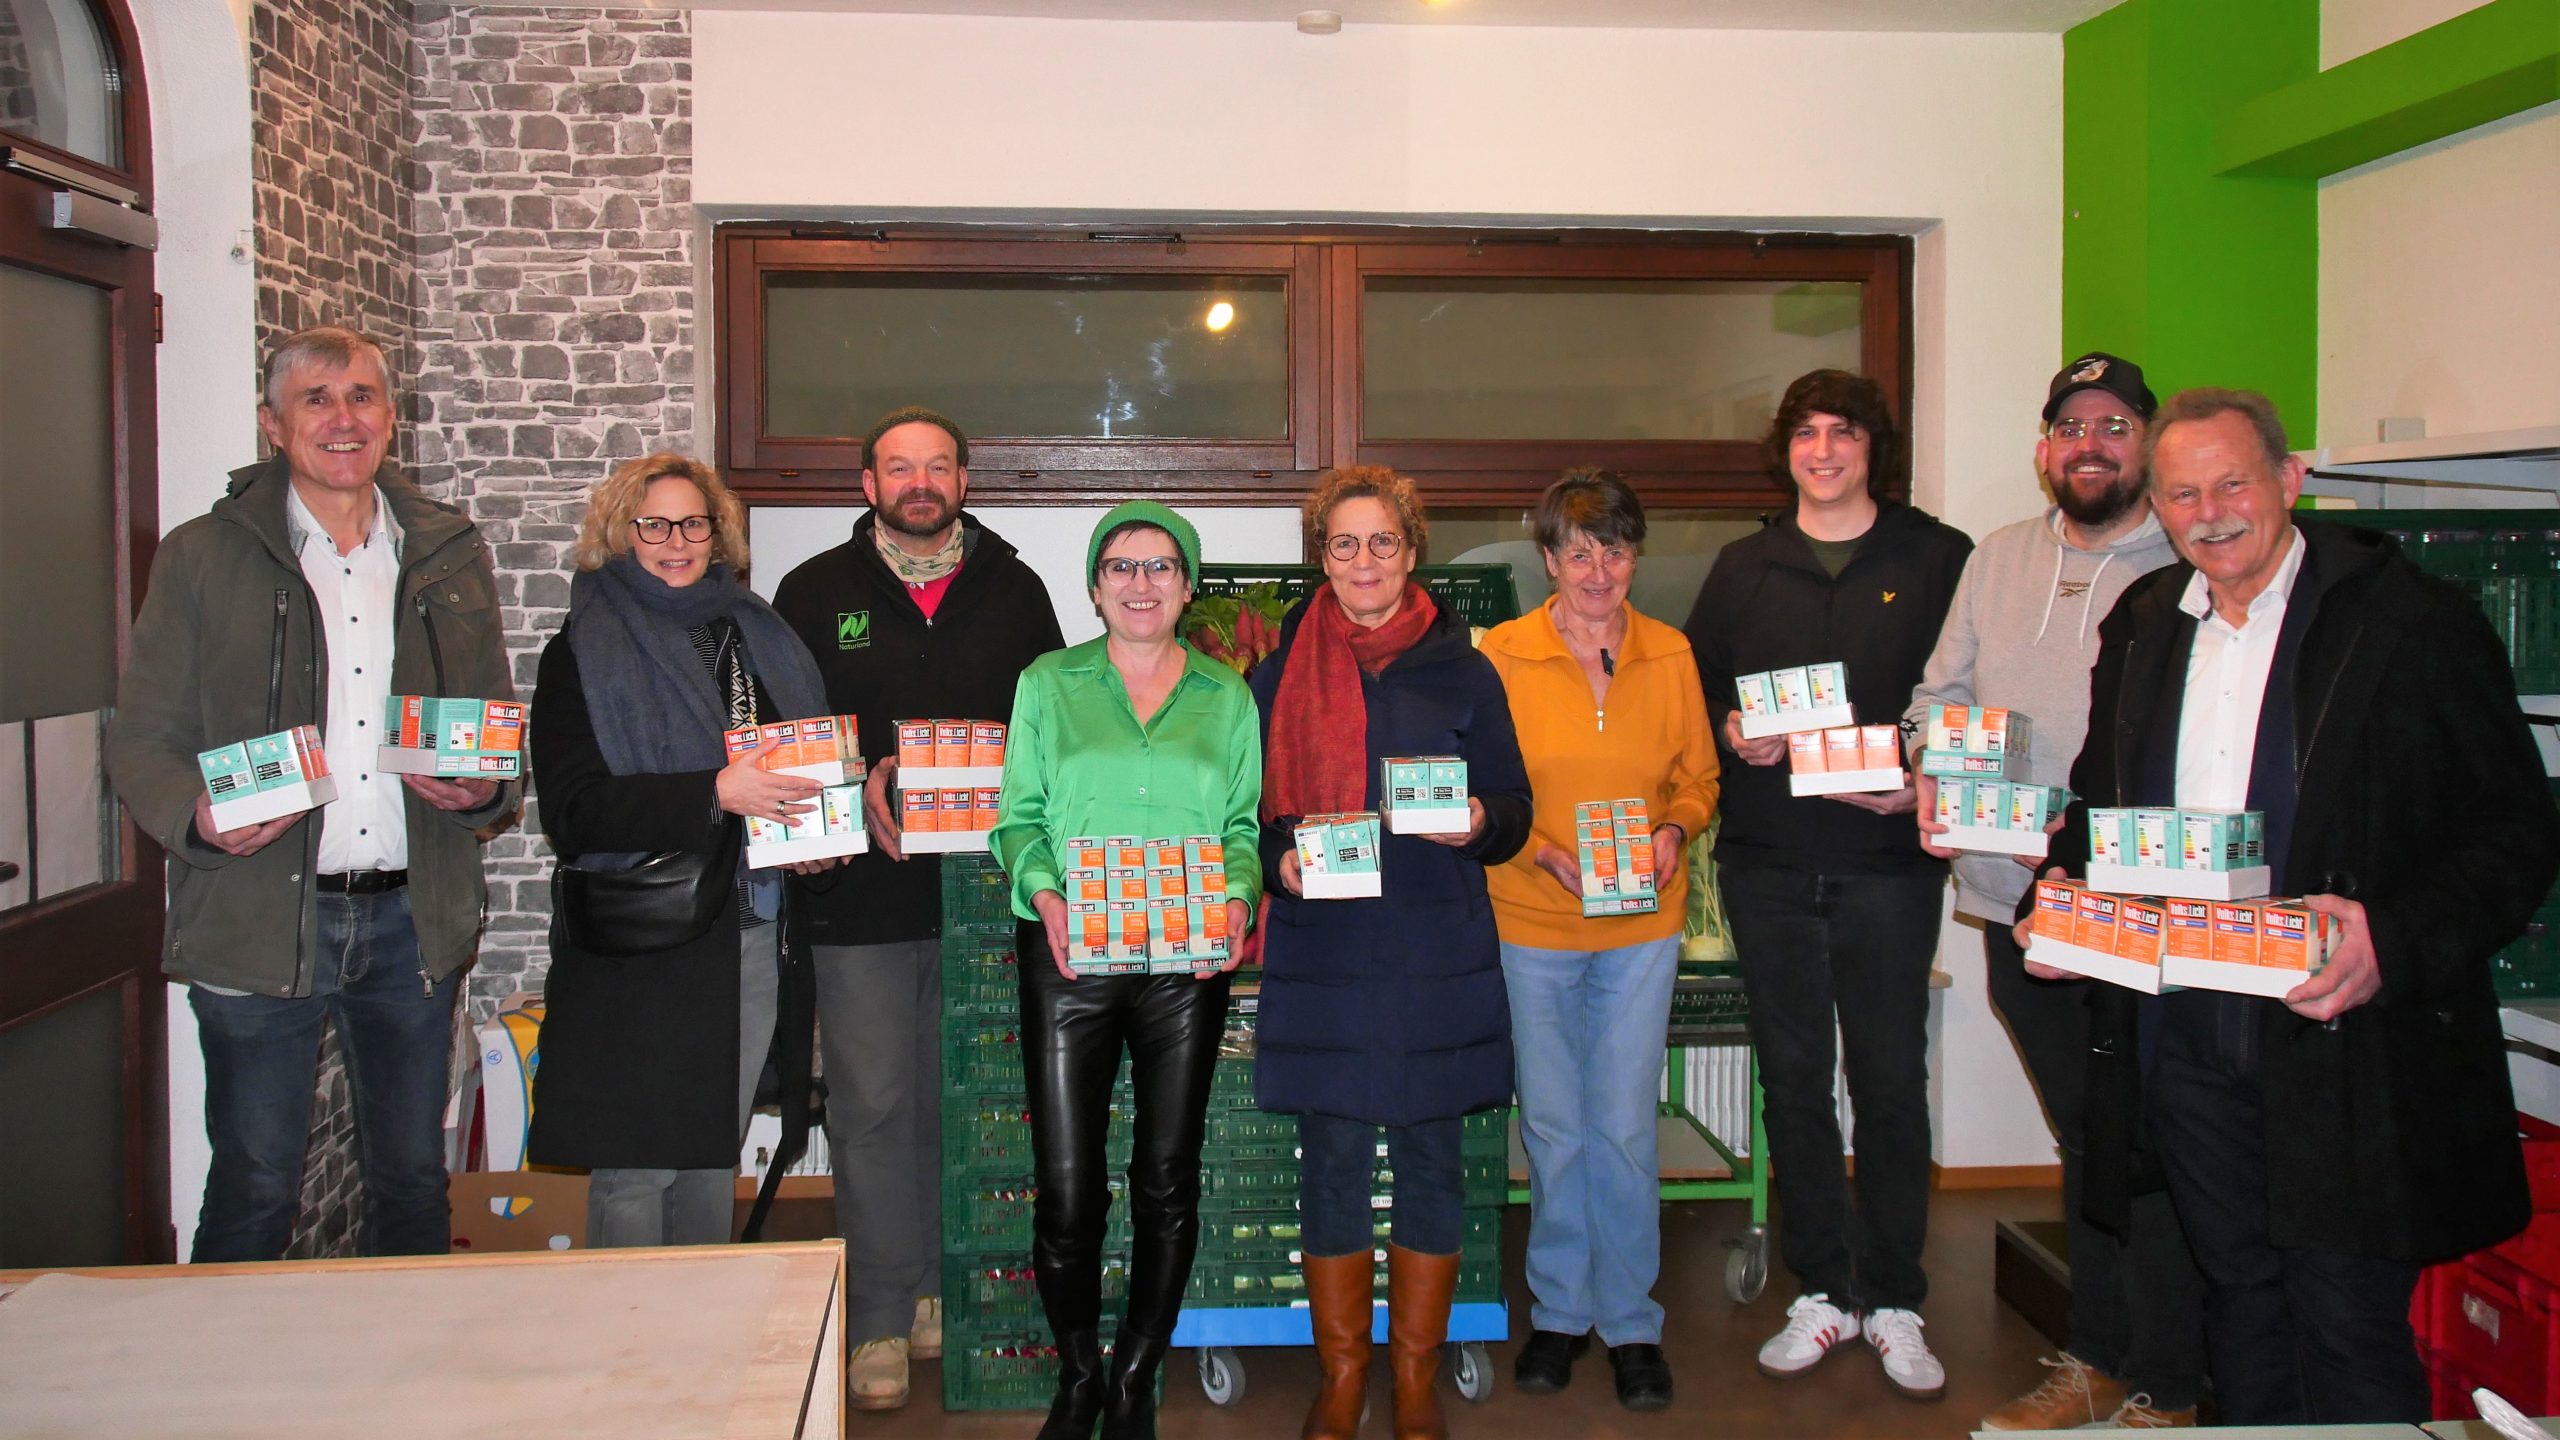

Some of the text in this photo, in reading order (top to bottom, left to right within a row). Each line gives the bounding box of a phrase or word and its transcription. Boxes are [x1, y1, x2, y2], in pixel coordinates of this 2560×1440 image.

[839, 640, 870, 650] Naturland
[2040, 886, 2073, 903] Volks.Licht
[2081, 896, 2114, 914] Volks.Licht
[2171, 903, 2206, 918] Volks.Licht
[2125, 906, 2160, 926] Volks.Licht
[2216, 907, 2253, 924] Volks.Licht
[2265, 912, 2304, 930] Volks.Licht
[1110, 963, 1144, 972] Volks.Licht
